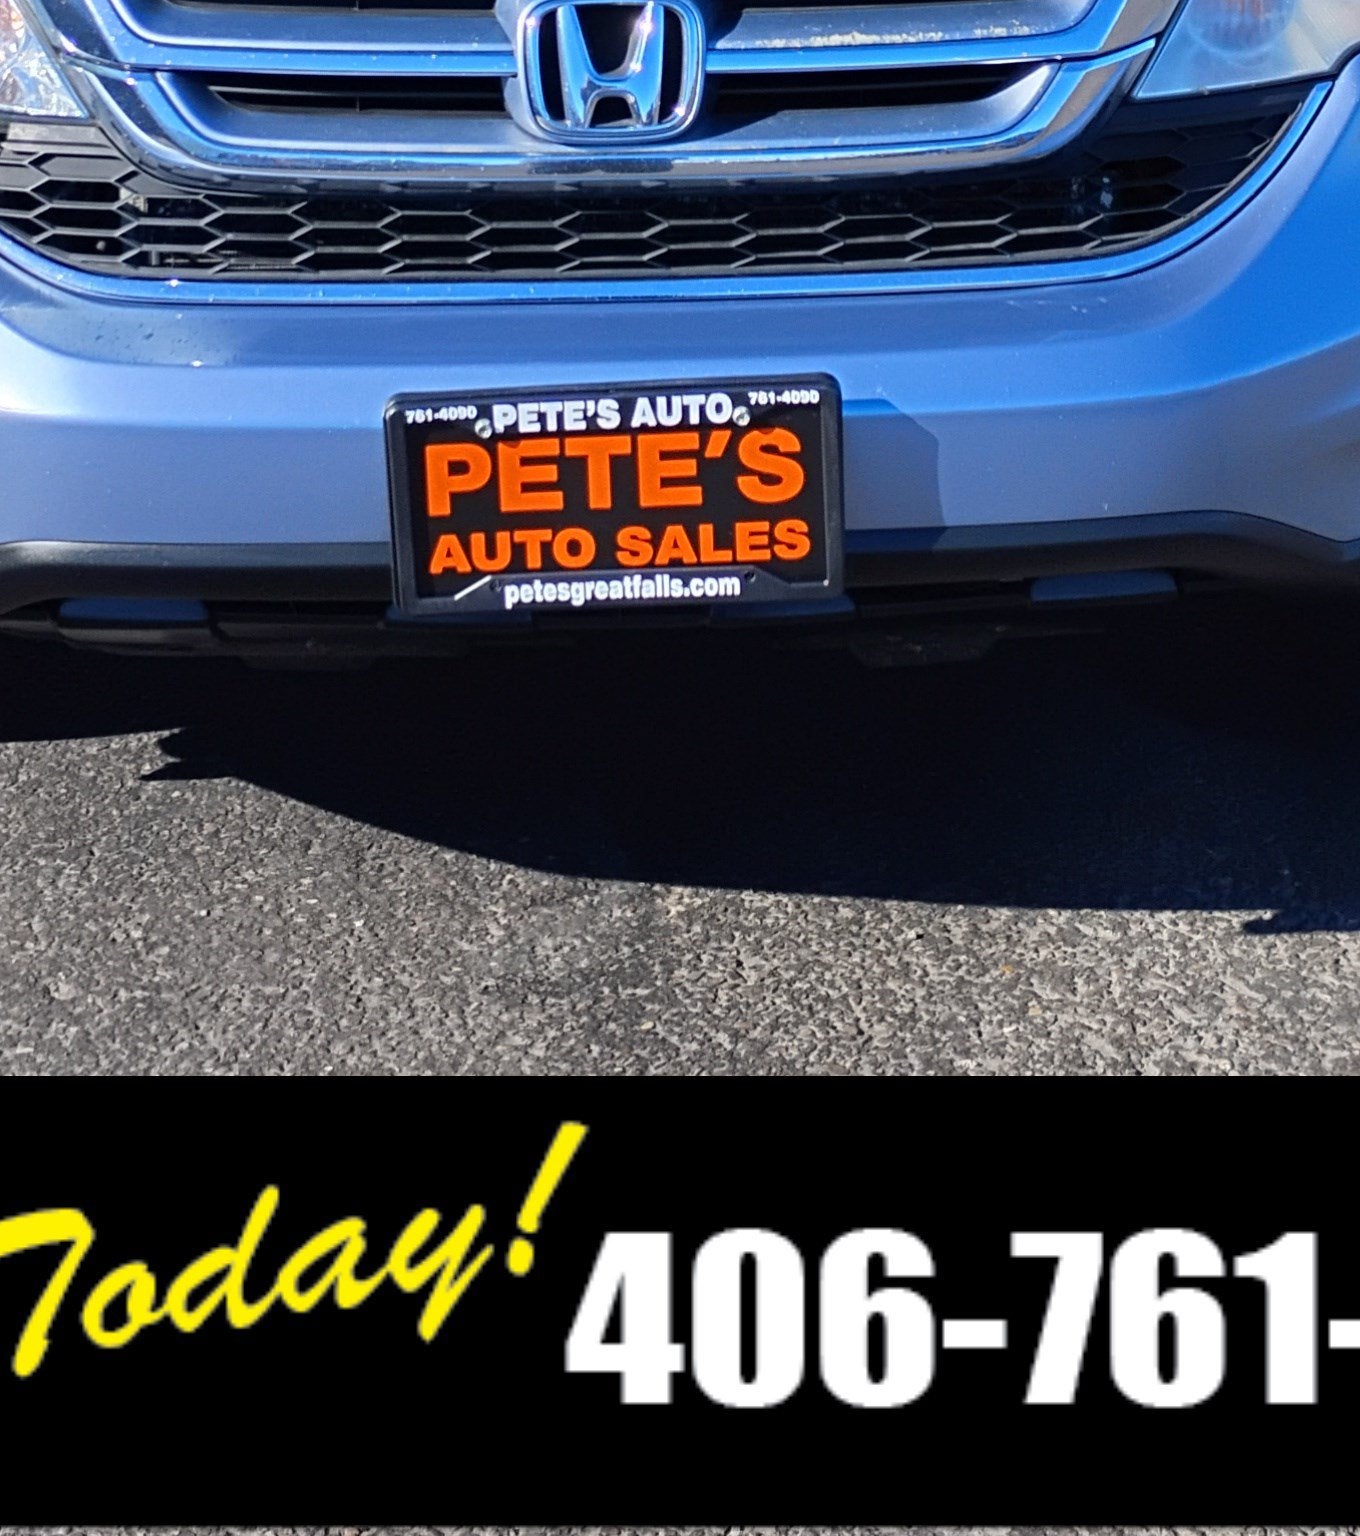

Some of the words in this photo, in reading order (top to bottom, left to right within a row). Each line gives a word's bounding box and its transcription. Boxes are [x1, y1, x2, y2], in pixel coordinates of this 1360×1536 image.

[492, 398, 621, 433] PETE'S
[630, 393, 733, 428] AUTO
[425, 427, 805, 517] PETE'S
[429, 527, 596, 575] AUTO
[616, 519, 811, 567] SALES
[504, 573, 741, 610] petesgreatfalls.com
